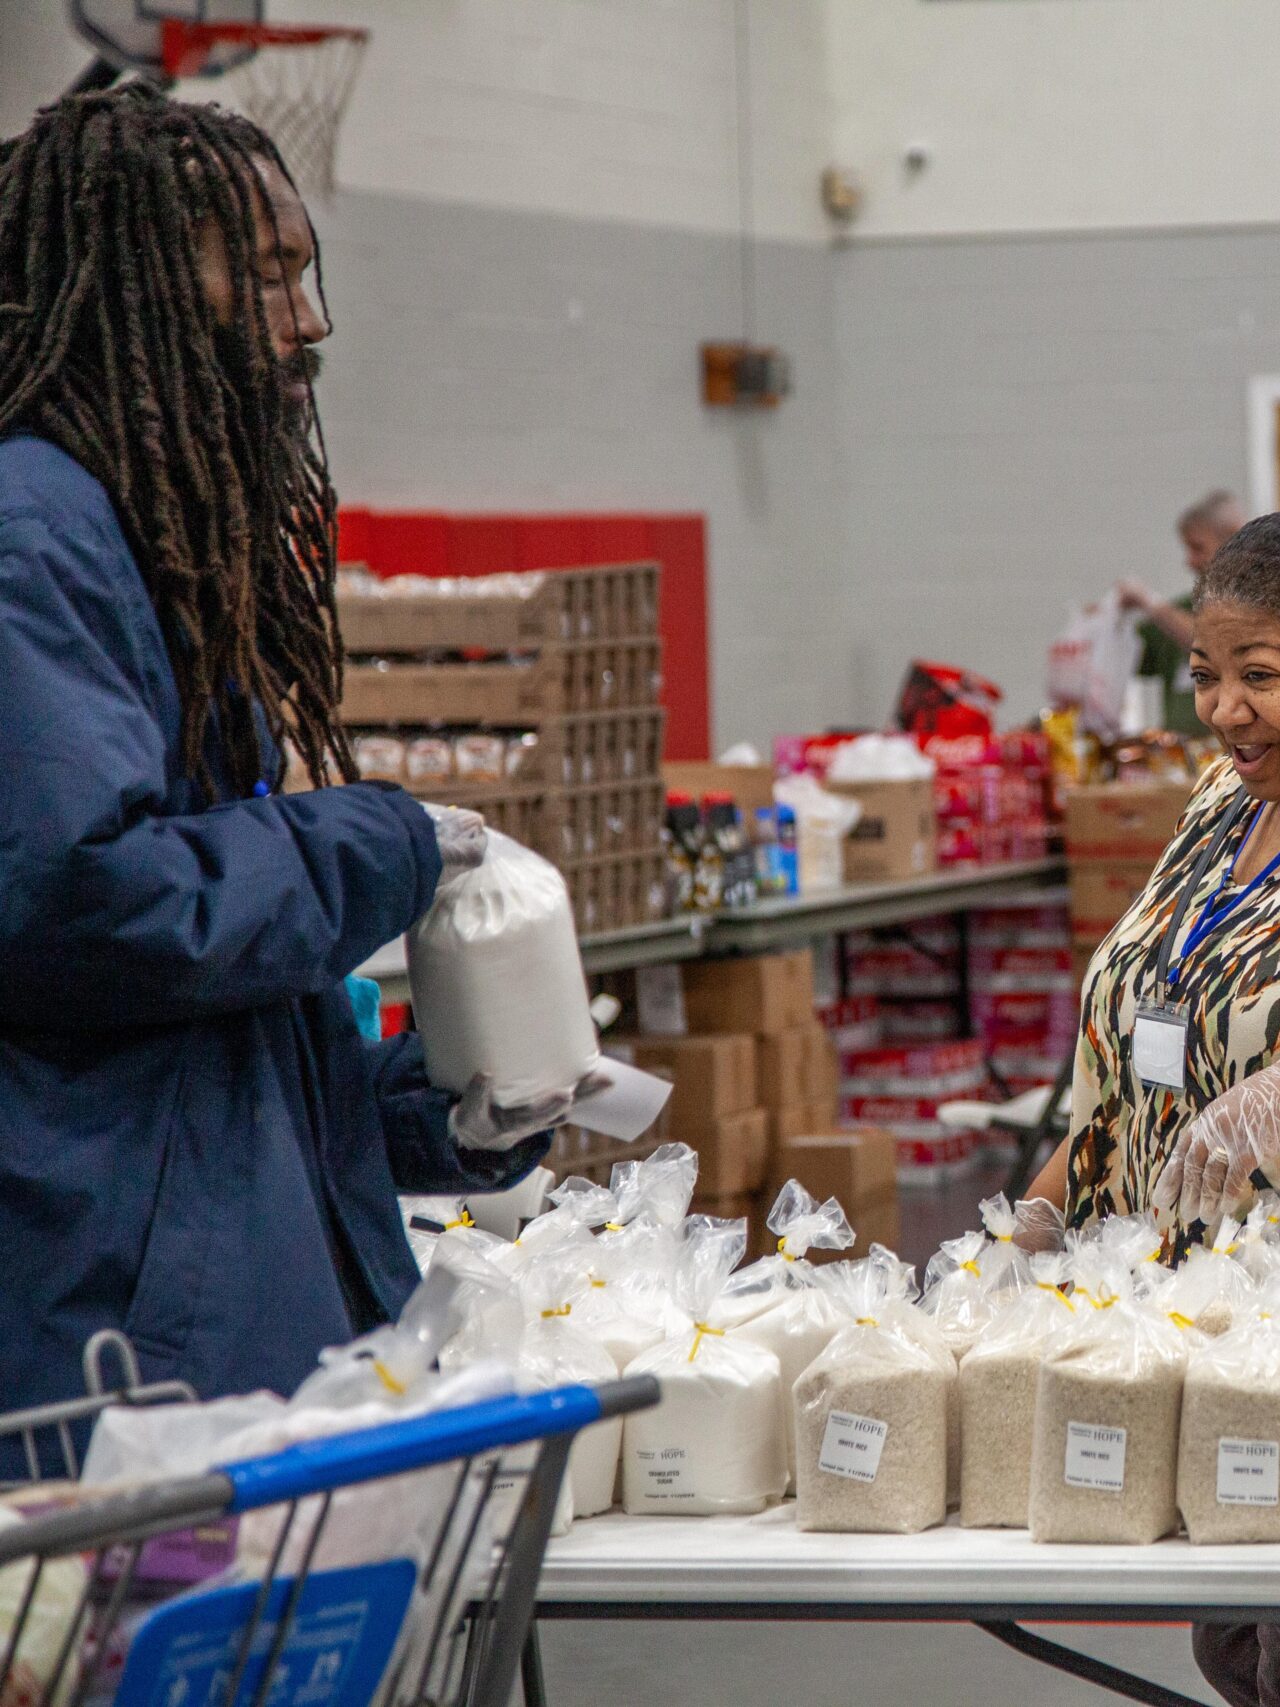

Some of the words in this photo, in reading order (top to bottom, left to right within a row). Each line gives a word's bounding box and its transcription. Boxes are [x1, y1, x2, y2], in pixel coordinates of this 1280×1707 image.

[854, 1421, 885, 1437] HOPE
[1093, 1431, 1123, 1443] HOPE
[661, 1450, 685, 1459] HOPE
[1246, 1446, 1277, 1457] HOPE
